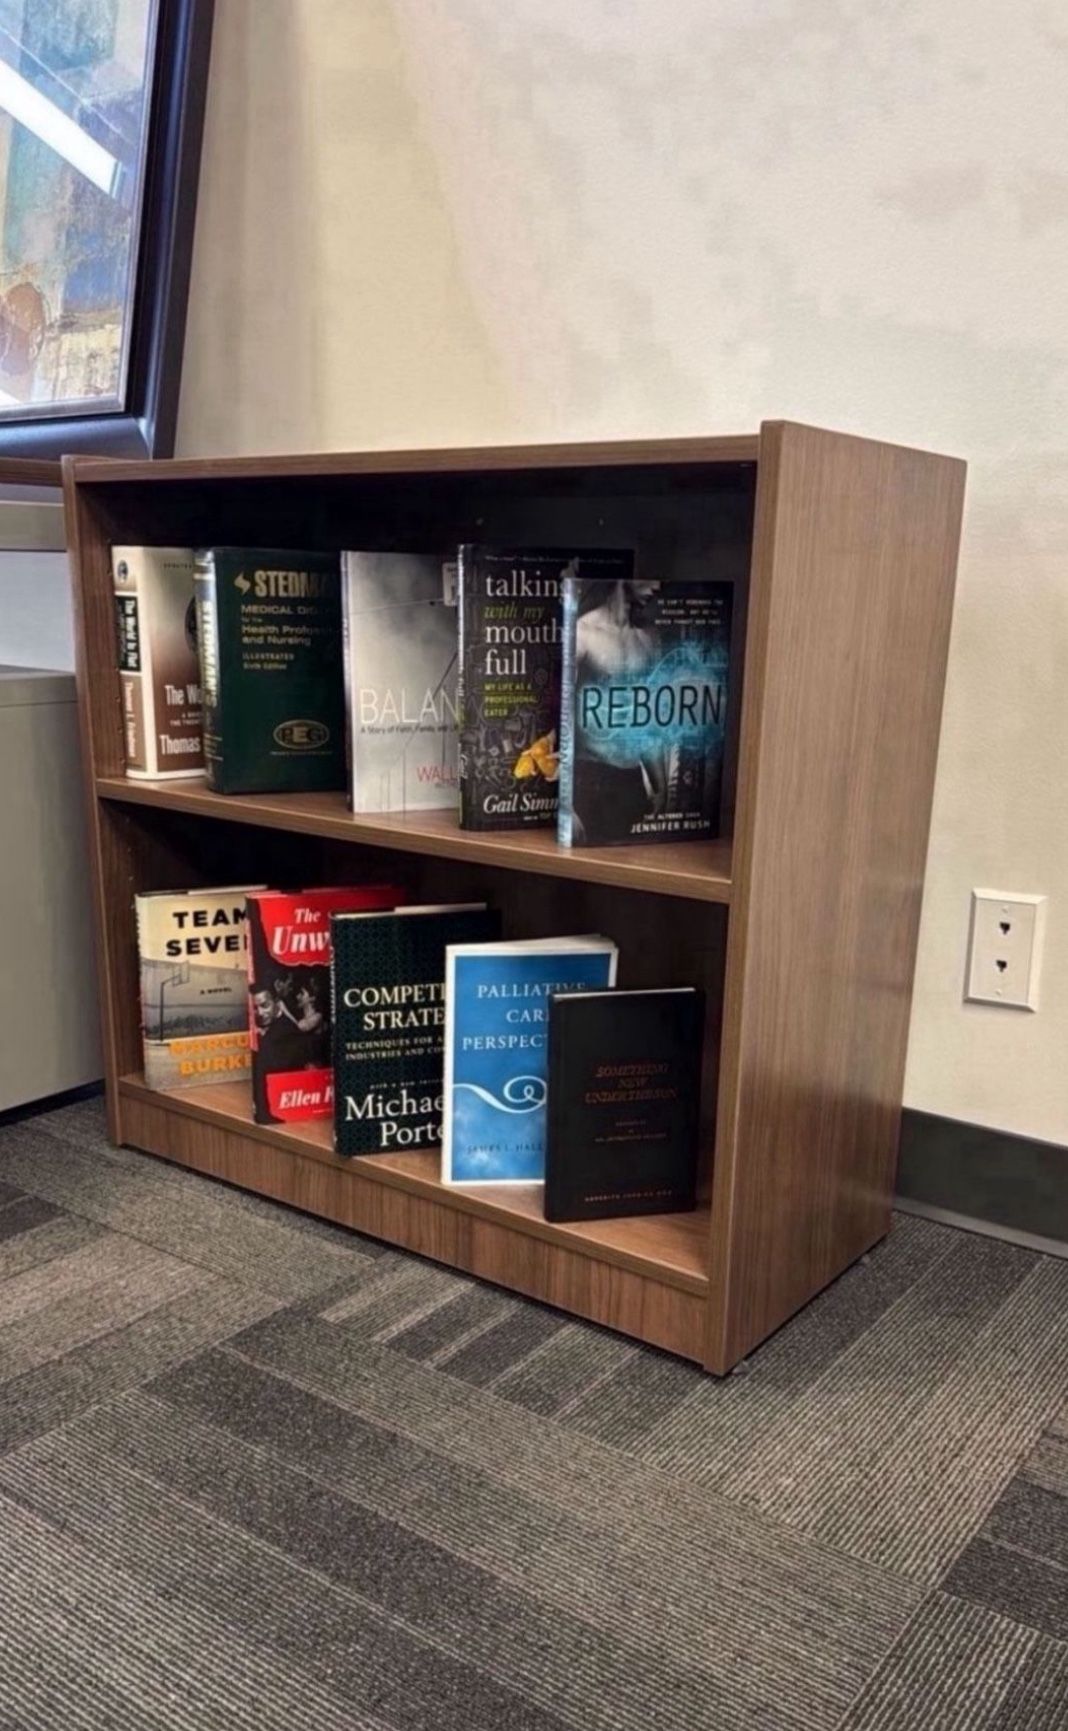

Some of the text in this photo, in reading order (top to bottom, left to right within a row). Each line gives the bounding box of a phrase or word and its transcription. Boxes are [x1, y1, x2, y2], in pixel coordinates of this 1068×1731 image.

[241, 604, 292, 615] MEDICAL
[484, 605, 517, 619] with
[241, 625, 279, 635] Health
[242, 636, 311, 648] and Nursing
[485, 649, 527, 675] full
[165, 685, 185, 704] The
[359, 689, 461, 723] BALAN
[582, 684, 723, 728] REBORN
[160, 735, 201, 754] Thomas
[483, 796, 518, 814] Gail
[631, 820, 710, 834] JENNIFER RUSH
[294, 908, 320, 924] The
[344, 983, 446, 1007] COMPETI
[363, 1008, 445, 1031] STRATE
[346, 1038, 410, 1050] TECHNIQUES
[413, 1036, 433, 1044] FOR
[462, 1033, 548, 1050] PERSPEC
[345, 1050, 401, 1061] INDUSTRIES
[405, 1047, 424, 1055] AND
[278, 1091, 321, 1109] Ellen
